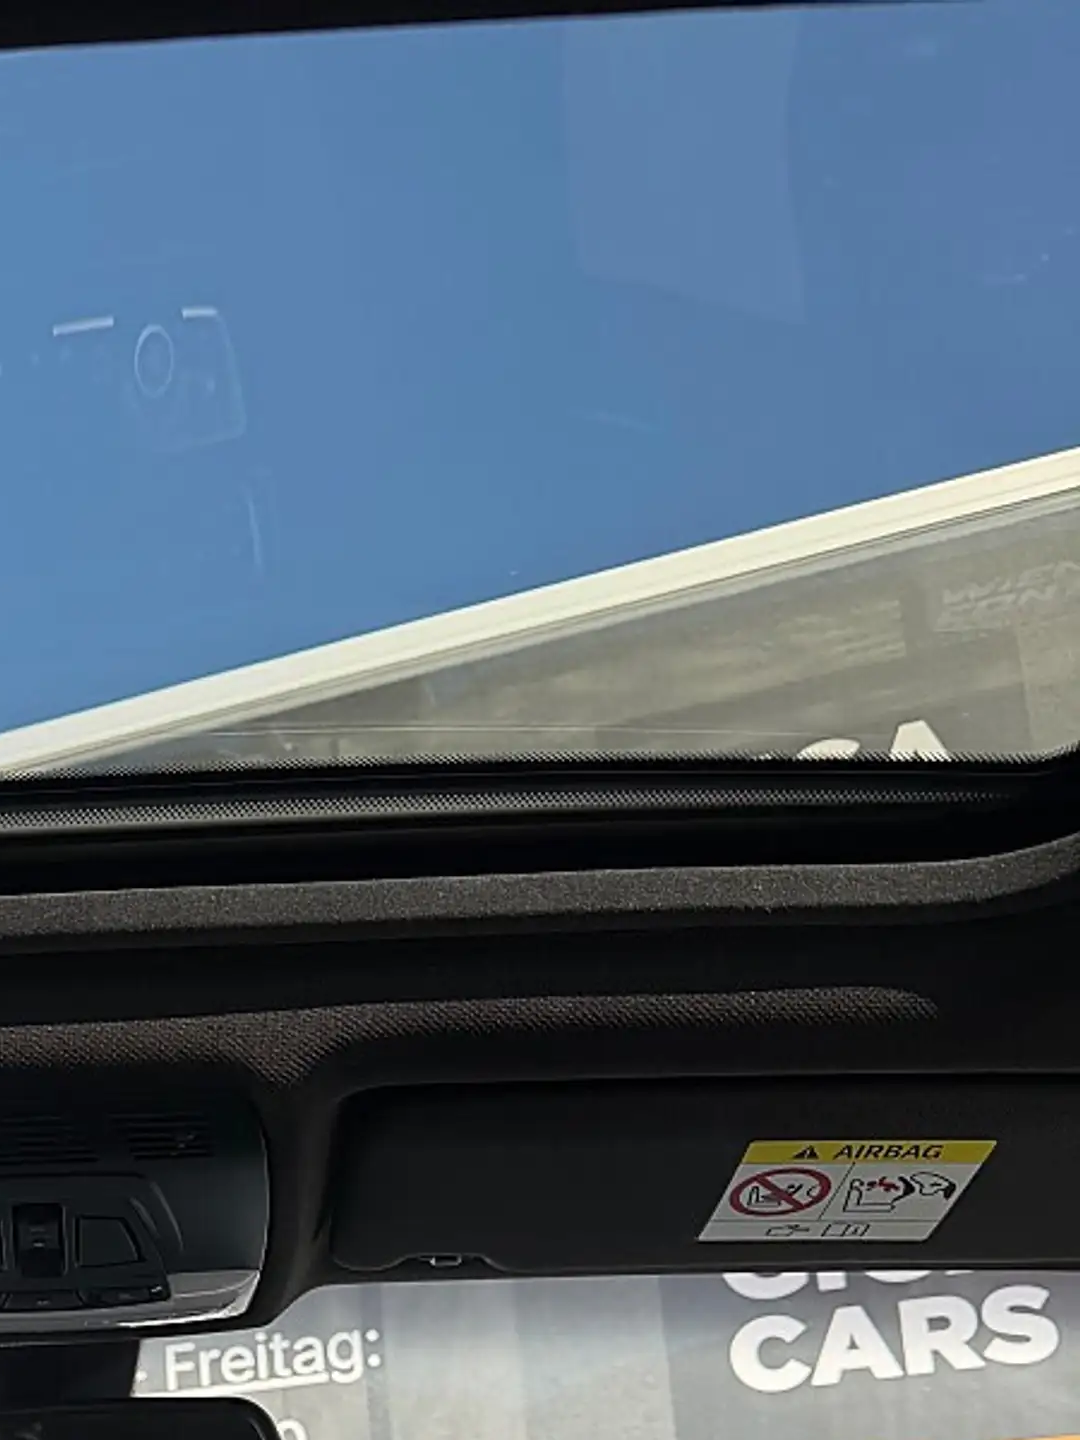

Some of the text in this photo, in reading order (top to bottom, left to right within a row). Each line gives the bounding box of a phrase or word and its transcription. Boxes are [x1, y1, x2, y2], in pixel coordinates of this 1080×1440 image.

[832, 1144, 944, 1160] AIRBAG
[165, 1327, 383, 1391] Freitag:
[729, 1285, 1061, 1393] CARS
